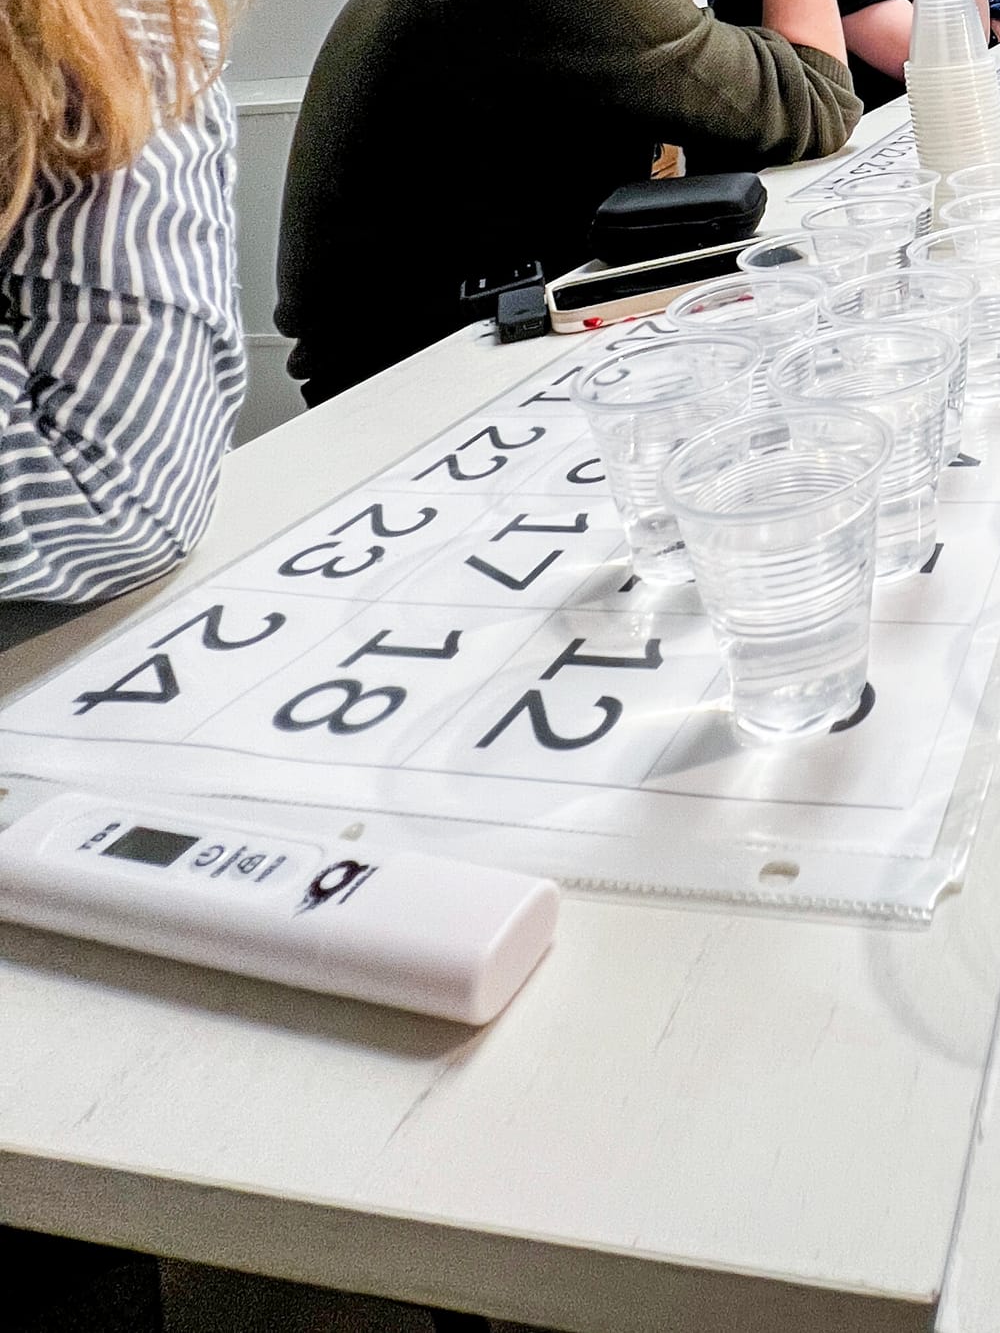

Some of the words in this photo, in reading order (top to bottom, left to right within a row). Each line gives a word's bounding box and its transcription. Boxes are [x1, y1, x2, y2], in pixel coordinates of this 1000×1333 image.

[413, 423, 547, 483] 22
[277, 501, 438, 580] 23
[463, 512, 590, 592] 17
[72, 604, 287, 716] 24
[272, 627, 461, 736] 18
[475, 637, 665, 751] 12
